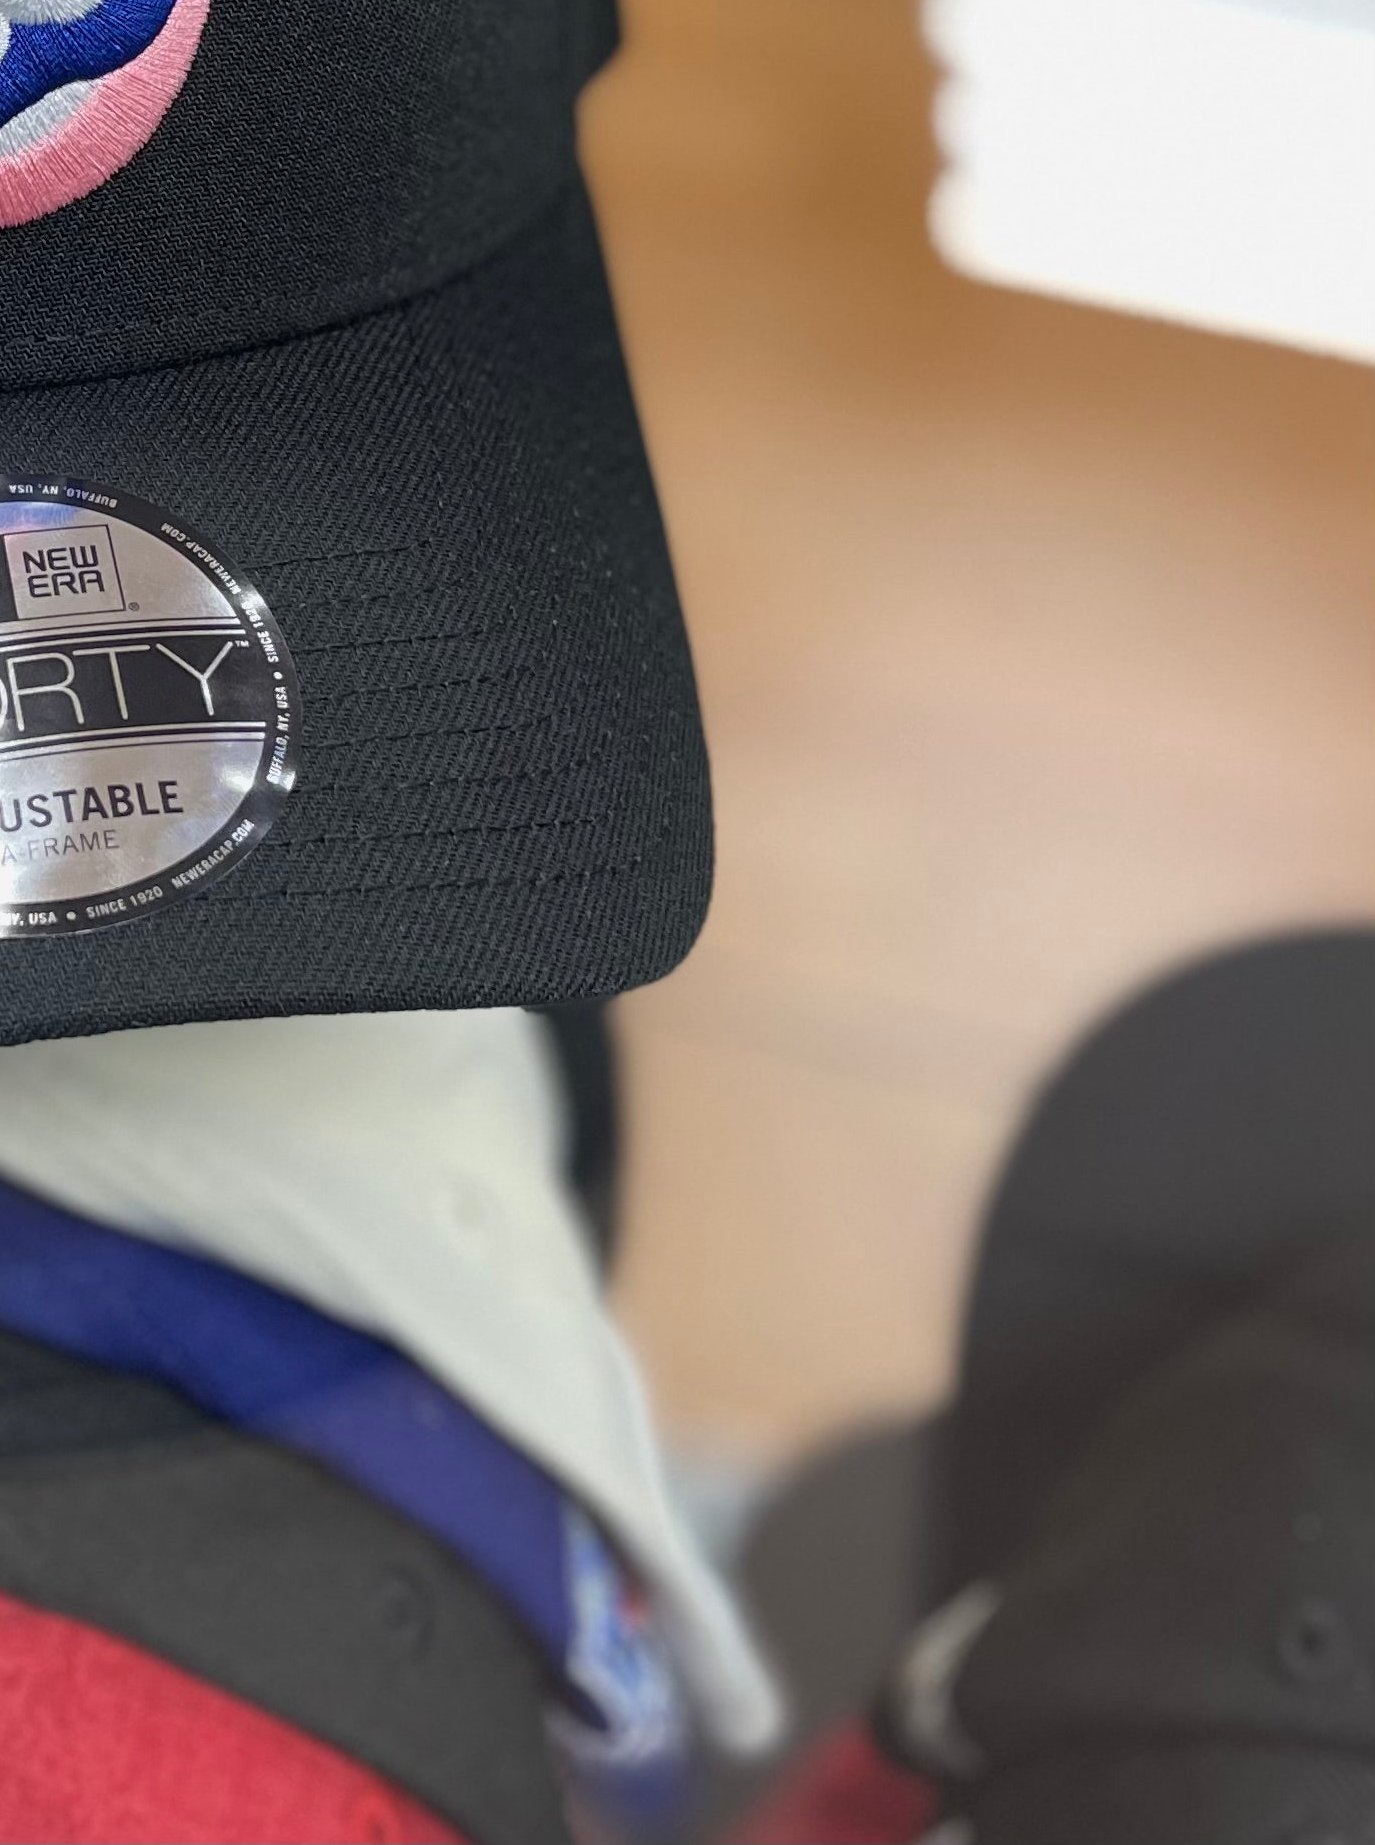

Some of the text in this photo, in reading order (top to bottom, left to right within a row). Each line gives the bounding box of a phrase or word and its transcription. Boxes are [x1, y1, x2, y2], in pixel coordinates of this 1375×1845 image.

[9, 484, 33, 494] USA
[22, 545, 99, 574] NEW
[160, 522, 242, 595] NEWERACAP.COM
[27, 570, 105, 598] ERA
[257, 630, 279, 663] SINCE
[276, 686, 290, 709] USA
[28, 911, 58, 926] USA
[86, 898, 127, 919] SINCE
[130, 885, 164, 907] 1920
[171, 818, 255, 890] NEWERACAP.COM
